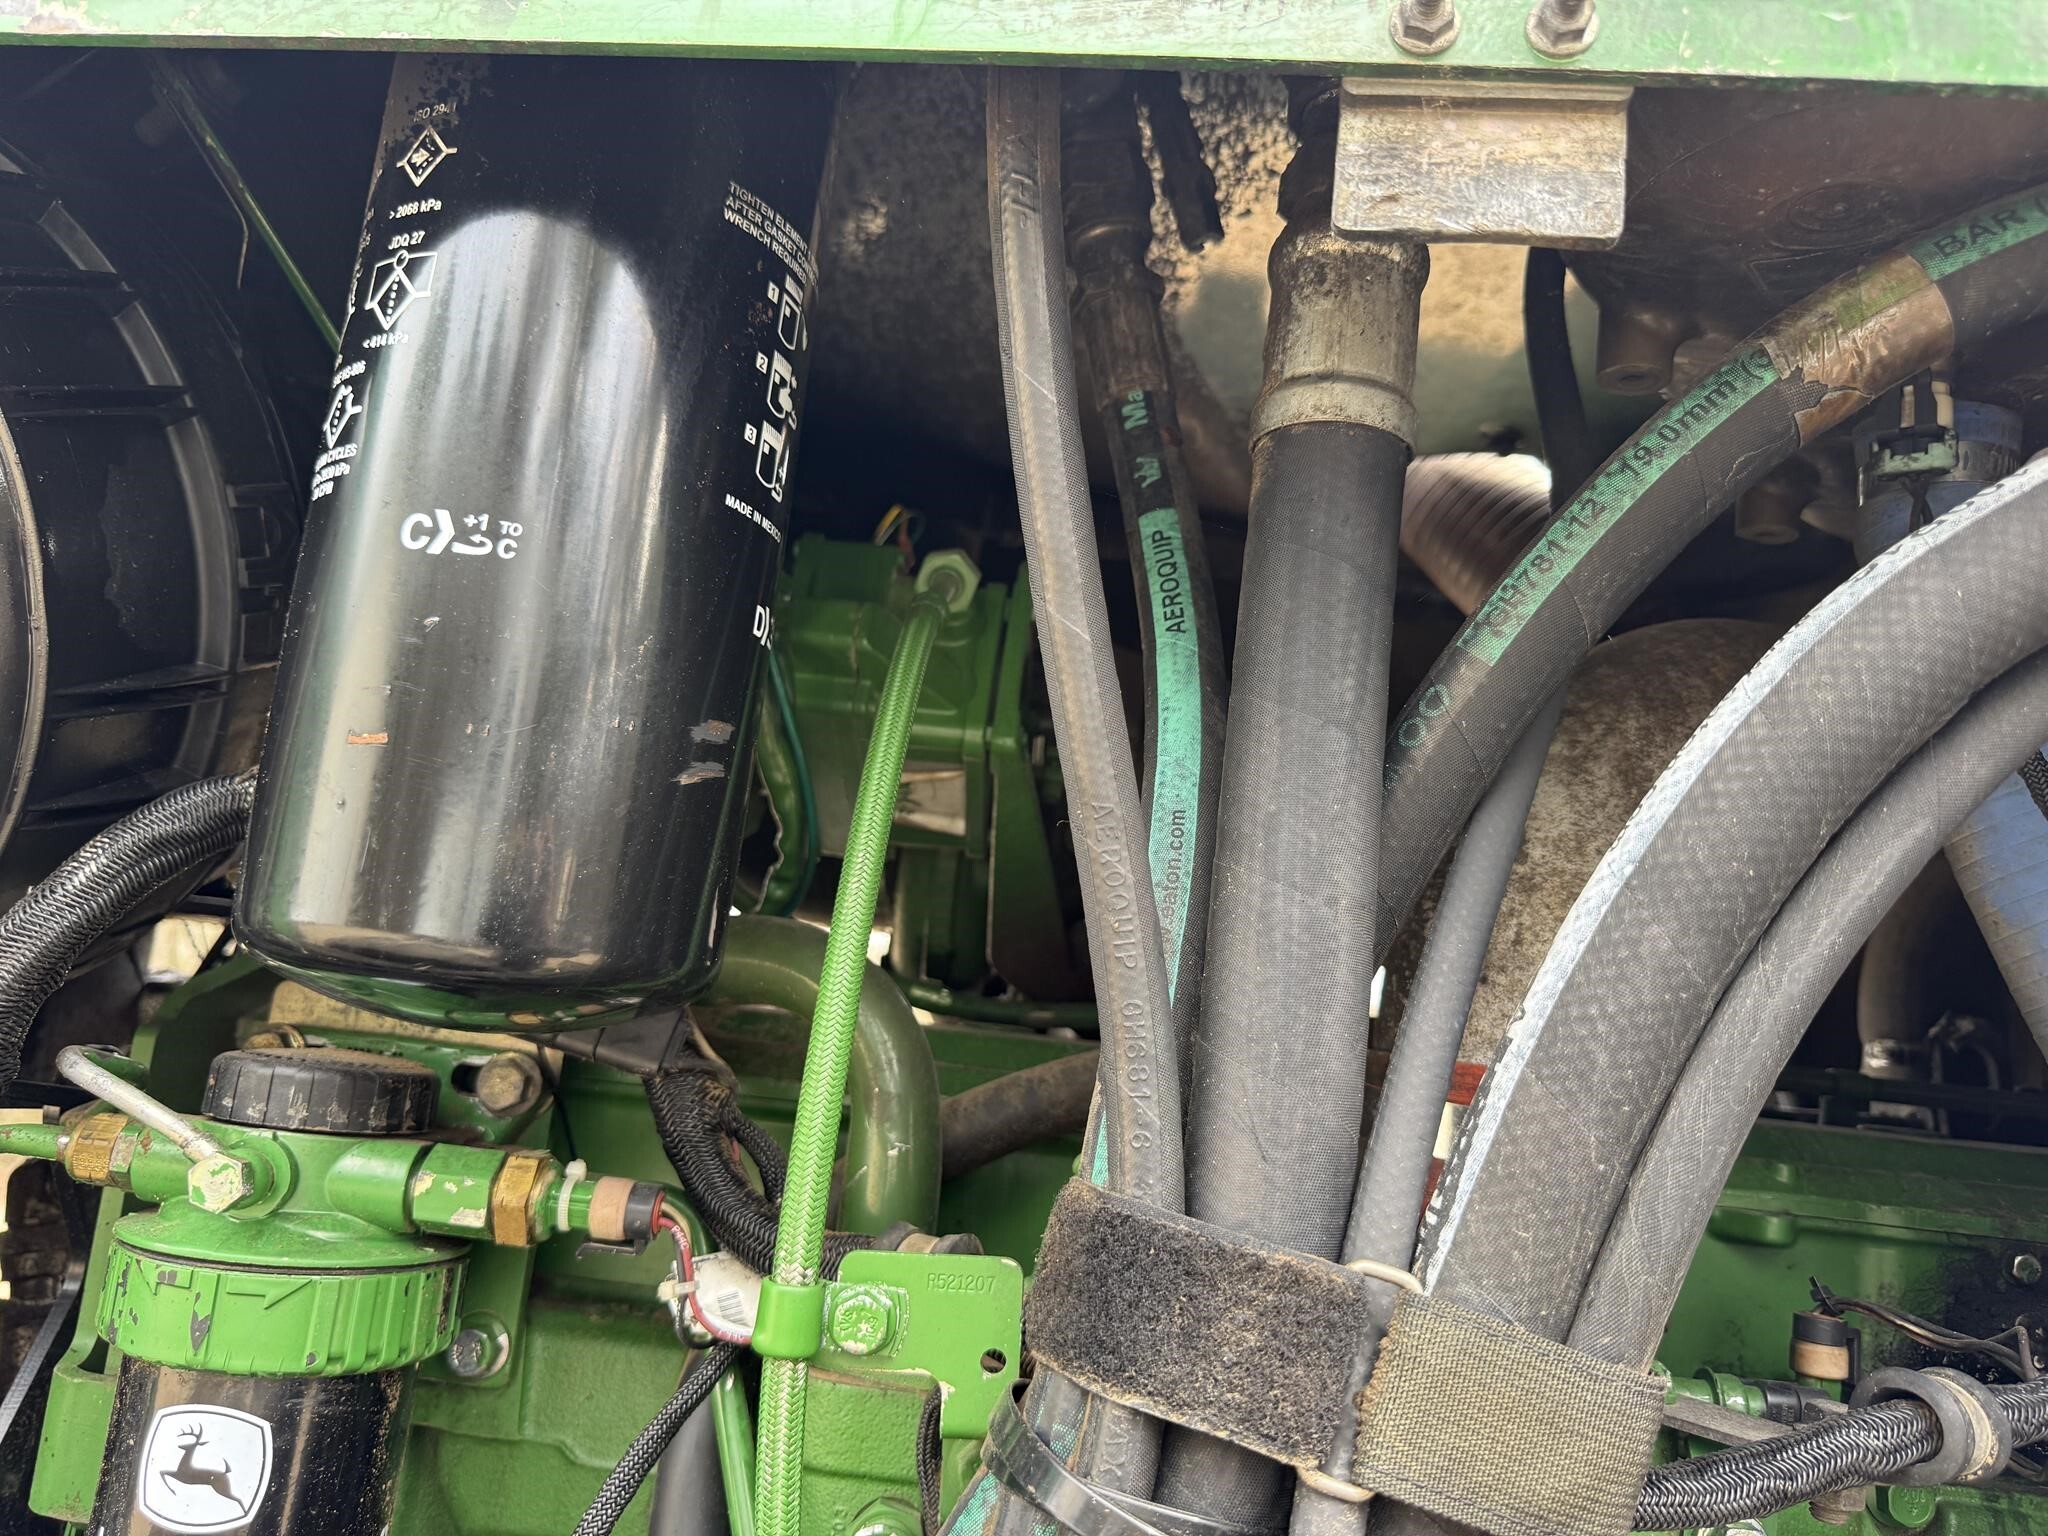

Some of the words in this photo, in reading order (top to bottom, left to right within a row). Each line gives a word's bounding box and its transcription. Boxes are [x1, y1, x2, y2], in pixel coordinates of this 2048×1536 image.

[419, 198, 442, 213] kPa
[726, 195, 763, 226] AFTER
[764, 220, 797, 256] GASKET
[729, 180, 775, 221] TIGHTEN
[775, 213, 808, 254] ELEMENT
[388, 233, 410, 250] JDQ
[410, 230, 426, 244] 27
[1932, 209, 2028, 257] BAR
[723, 206, 771, 249] WRENCH
[771, 240, 807, 285] REQUIRED
[770, 287, 776, 299] 1
[387, 332, 409, 346] kPa
[759, 356, 766, 370] 2
[747, 427, 755, 443] 3
[498, 520, 523, 537] TO
[725, 493, 753, 518] MADE
[753, 510, 762, 525] IN
[762, 516, 781, 543] MEXICO
[496, 538, 518, 559] C
[1152, 529, 1186, 635] AEROQUIP
[1091, 800, 1138, 969] AEROQUIP
[926, 1272, 997, 1294] R521207
